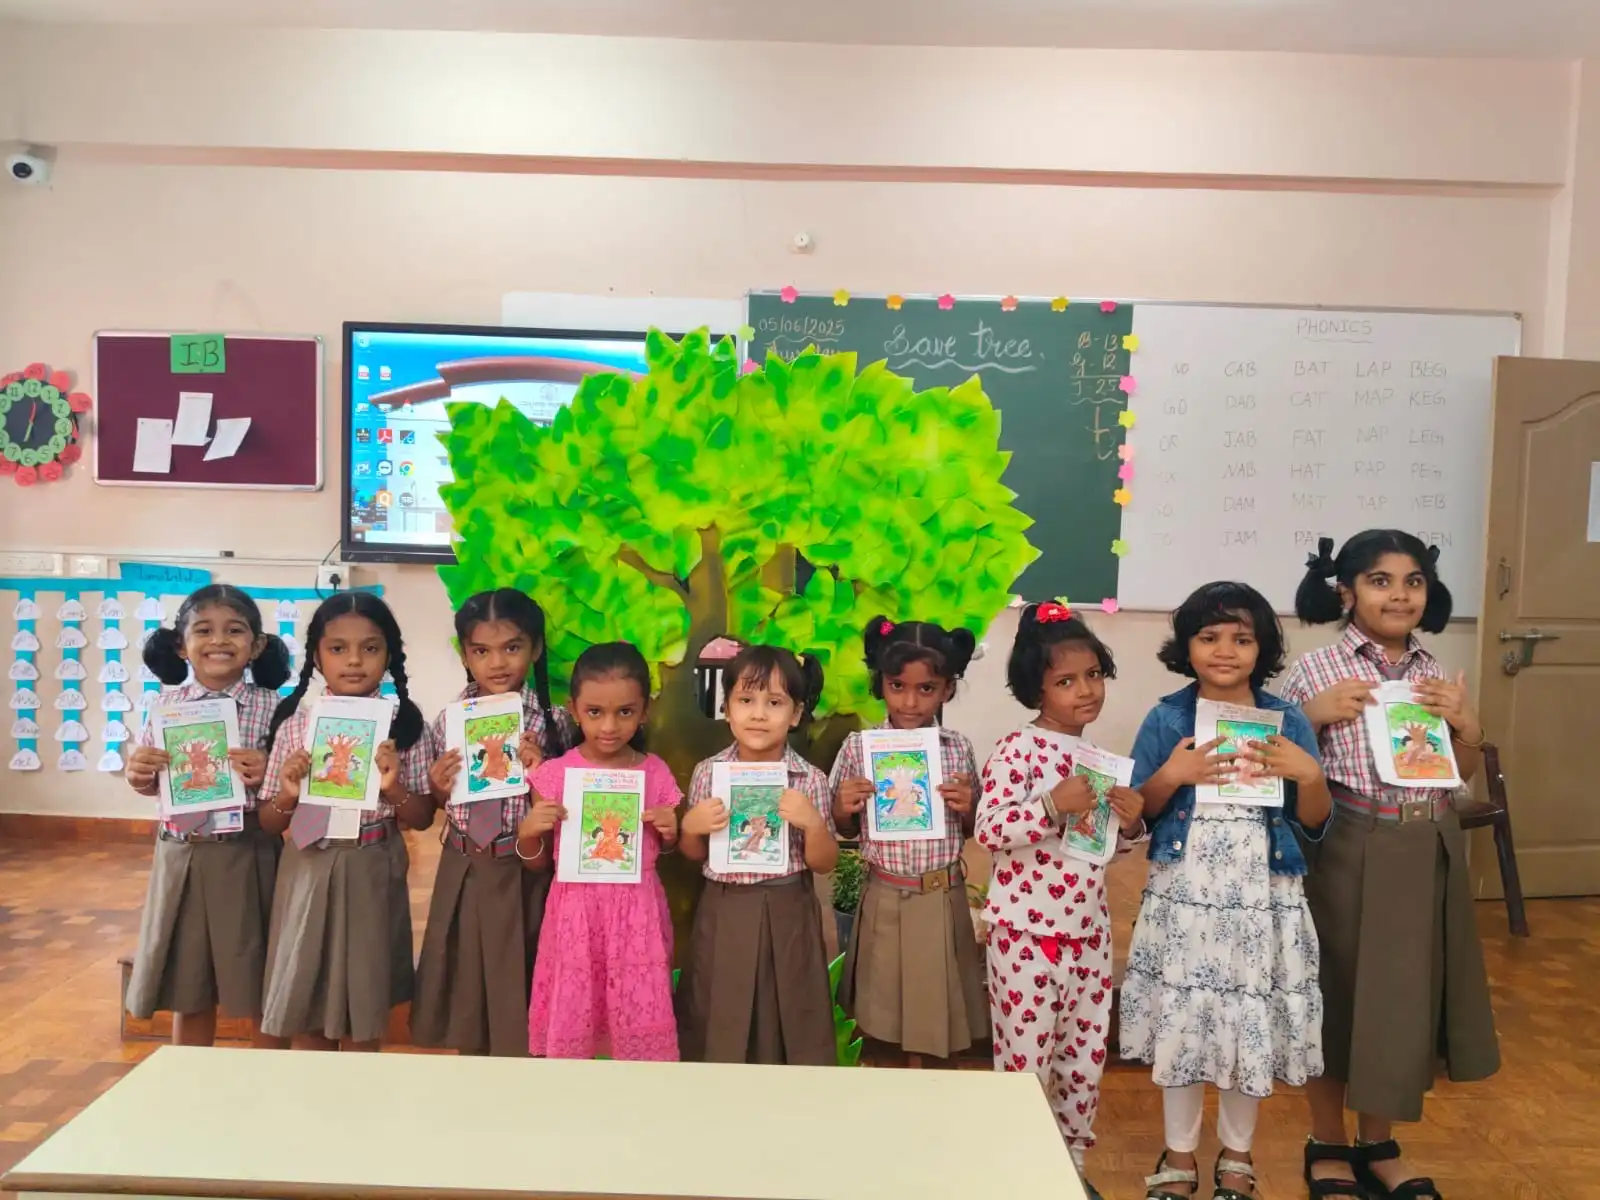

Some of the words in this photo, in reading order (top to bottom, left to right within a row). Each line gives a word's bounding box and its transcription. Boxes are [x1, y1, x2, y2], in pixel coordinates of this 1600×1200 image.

[758, 315, 846, 337] 05/06/2025
[1296, 317, 1374, 336] PHONICS
[884, 322, 957, 356] Save
[180, 339, 220, 367] IB
[1223, 359, 1258, 378] CAB
[1293, 359, 1333, 377] BAT
[1355, 360, 1393, 379] LAP
[1289, 390, 1331, 409] CAT
[1354, 388, 1396, 406] MAP
[1408, 390, 1448, 408] KEG
[1292, 429, 1328, 450] FAT
[1356, 423, 1390, 444] NAP
[1220, 459, 1257, 480] NAB
[1290, 460, 1327, 480] HAT
[1223, 495, 1256, 513] DAM
[1355, 494, 1389, 511] TAP
[1219, 529, 1258, 548] JAM
